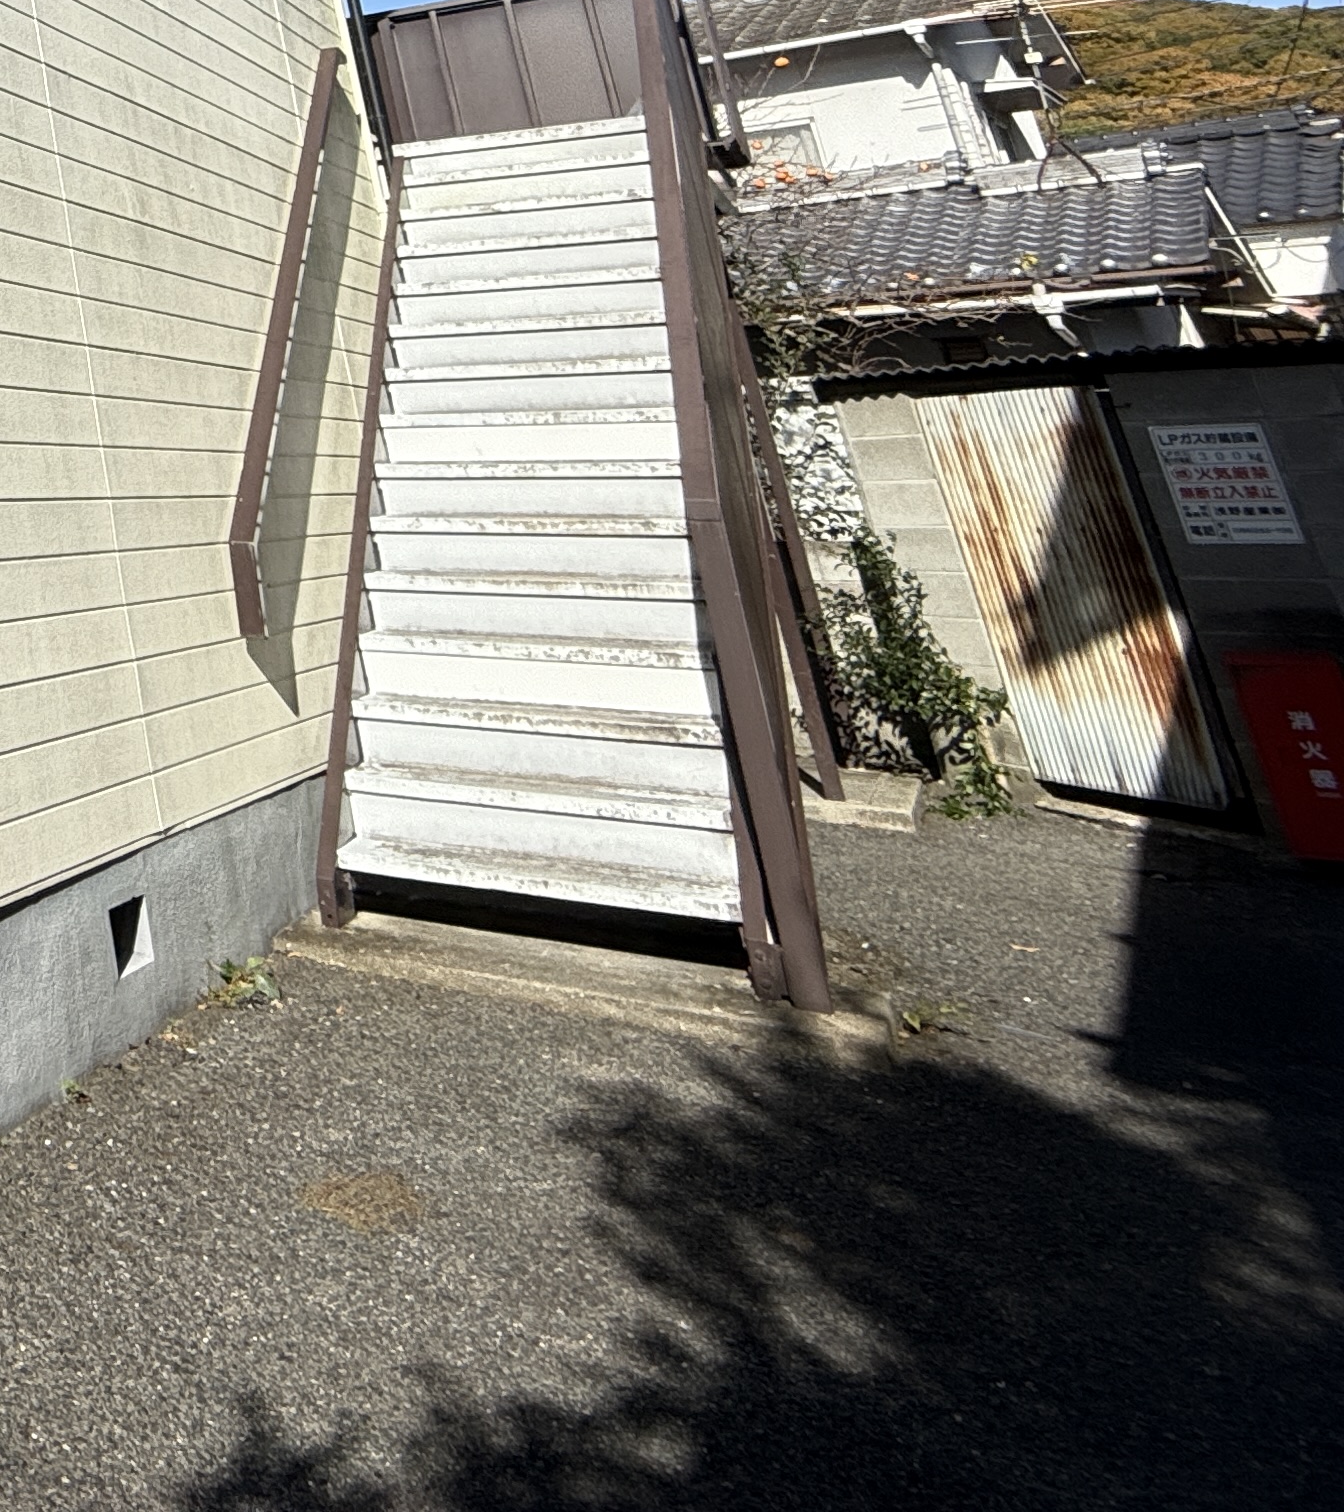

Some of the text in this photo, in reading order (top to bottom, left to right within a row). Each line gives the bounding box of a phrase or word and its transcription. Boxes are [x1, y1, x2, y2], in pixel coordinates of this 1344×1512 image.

[1194, 466, 1271, 481] 火気厳禁
[1179, 485, 1280, 500] 無断立入禁止
[1286, 710, 1339, 789] 消火器
